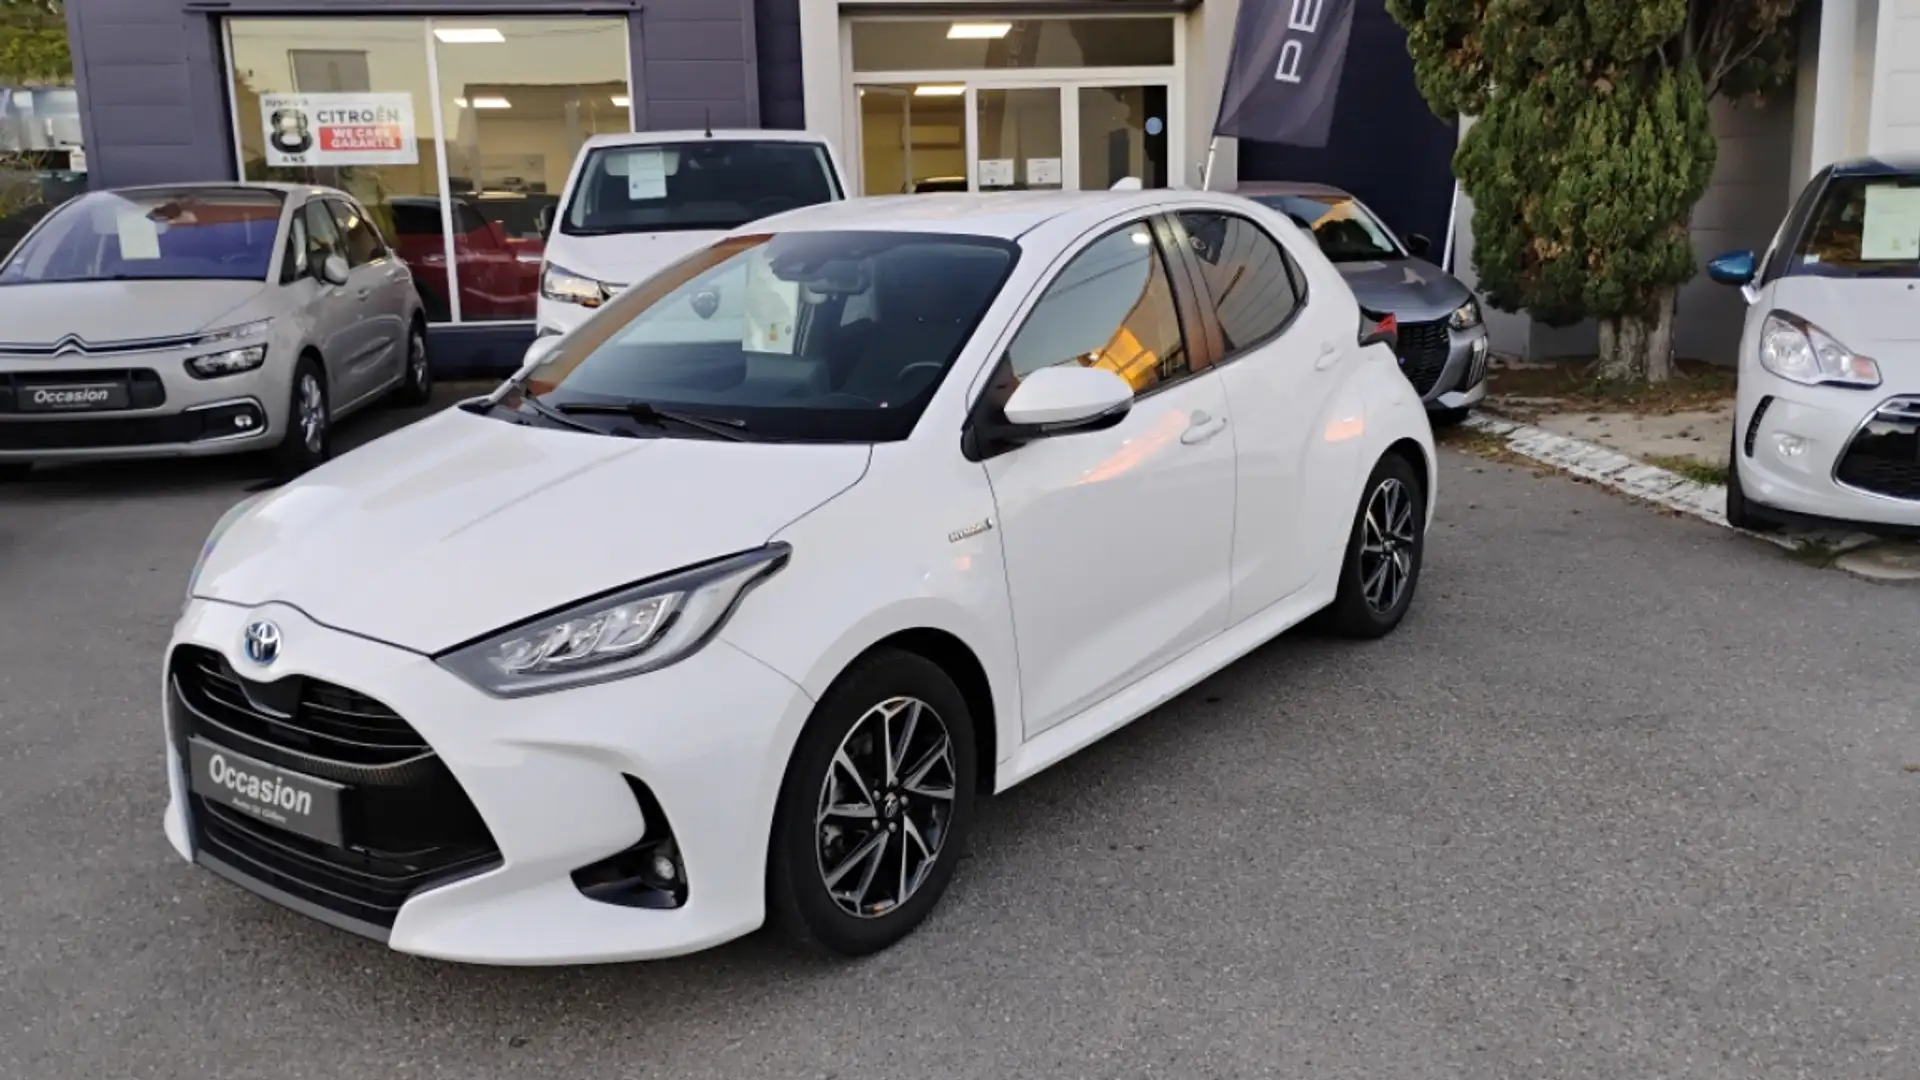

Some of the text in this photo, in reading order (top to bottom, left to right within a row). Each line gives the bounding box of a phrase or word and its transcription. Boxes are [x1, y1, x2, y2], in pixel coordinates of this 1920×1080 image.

[271, 109, 313, 153] 8
[34, 388, 108, 403] Occasion
[209, 754, 312, 815] Occasion
